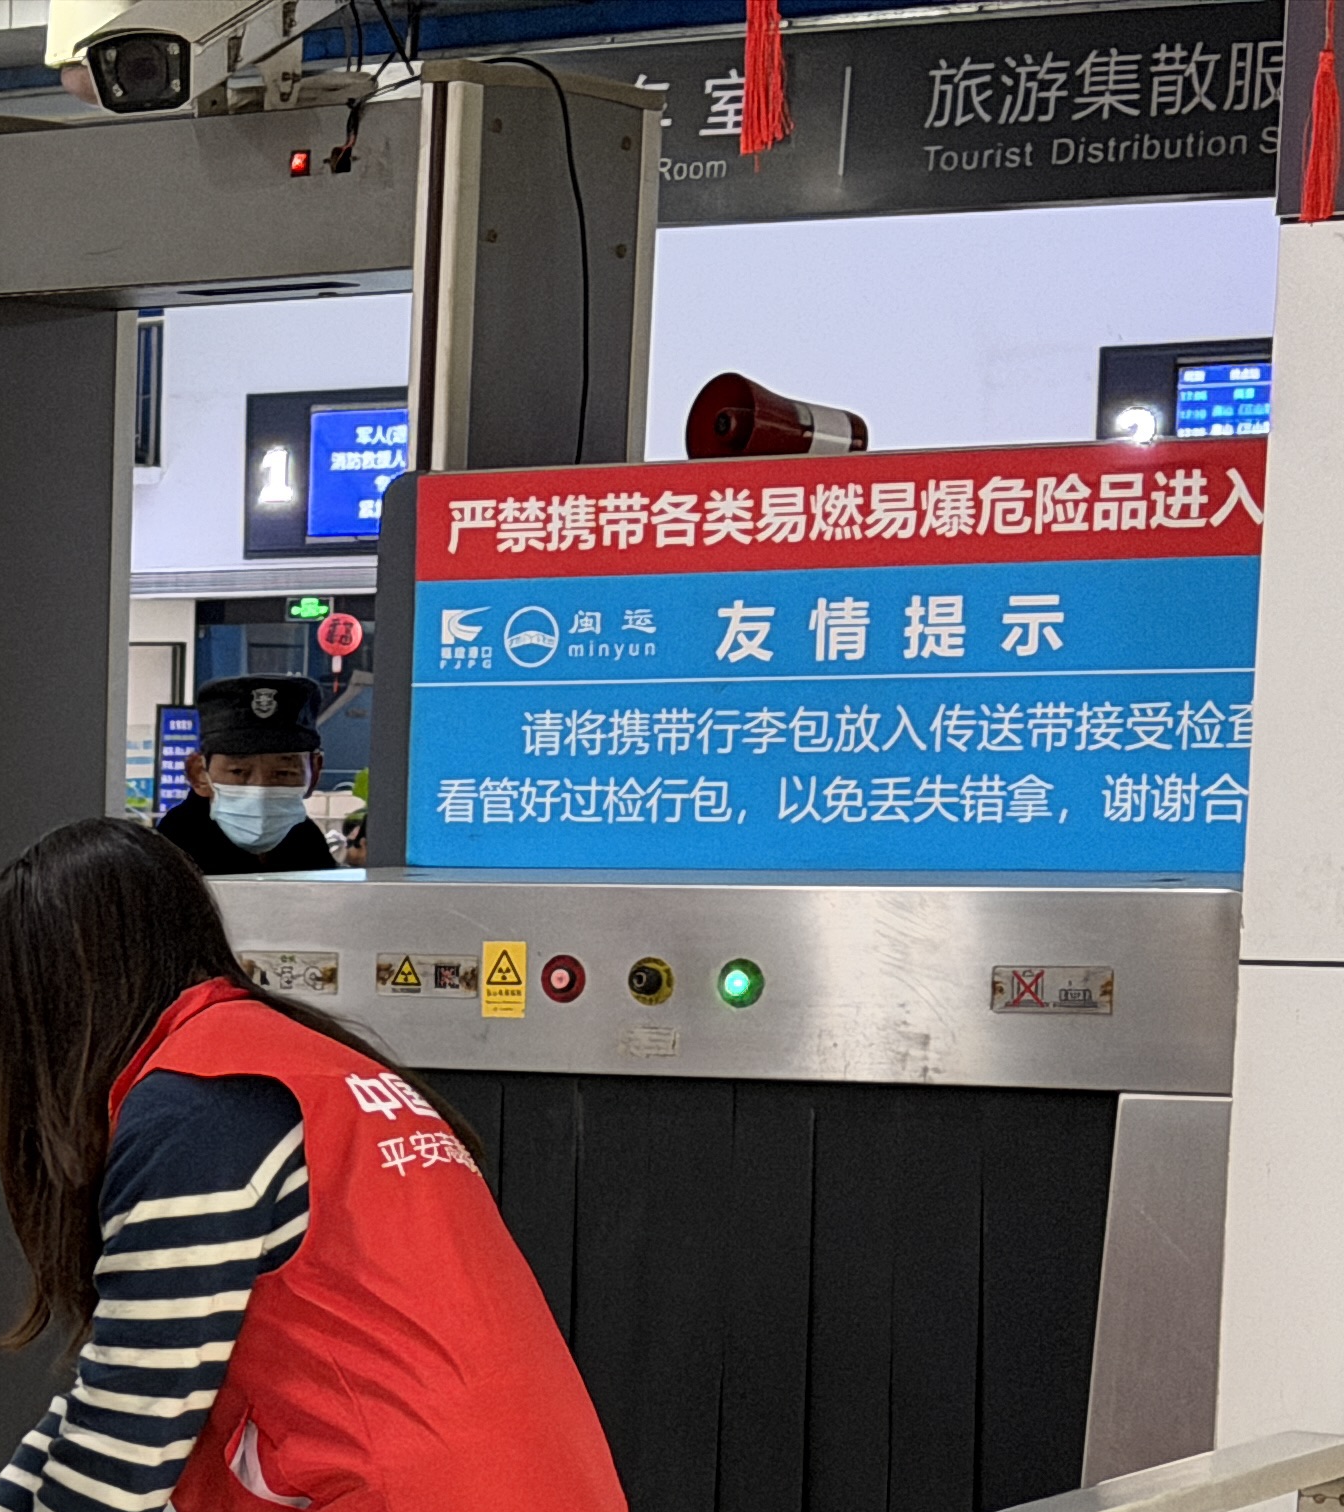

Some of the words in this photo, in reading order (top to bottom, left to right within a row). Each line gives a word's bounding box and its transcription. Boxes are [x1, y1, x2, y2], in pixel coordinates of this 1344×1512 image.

[924, 40, 1283, 129] 旅游集散服
[658, 157, 727, 181] Room
[924, 140, 1034, 172] Tourist
[1050, 133, 1249, 168] Distribution
[258, 446, 294, 504] 1
[448, 467, 1265, 555] 严禁携带各类易燃易爆危险品进入
[568, 608, 657, 635] 闽运
[714, 593, 1066, 664] 友情提示
[568, 640, 656, 661] minyun
[521, 701, 1254, 758] 请将携带行李包放入传送带接受检查
